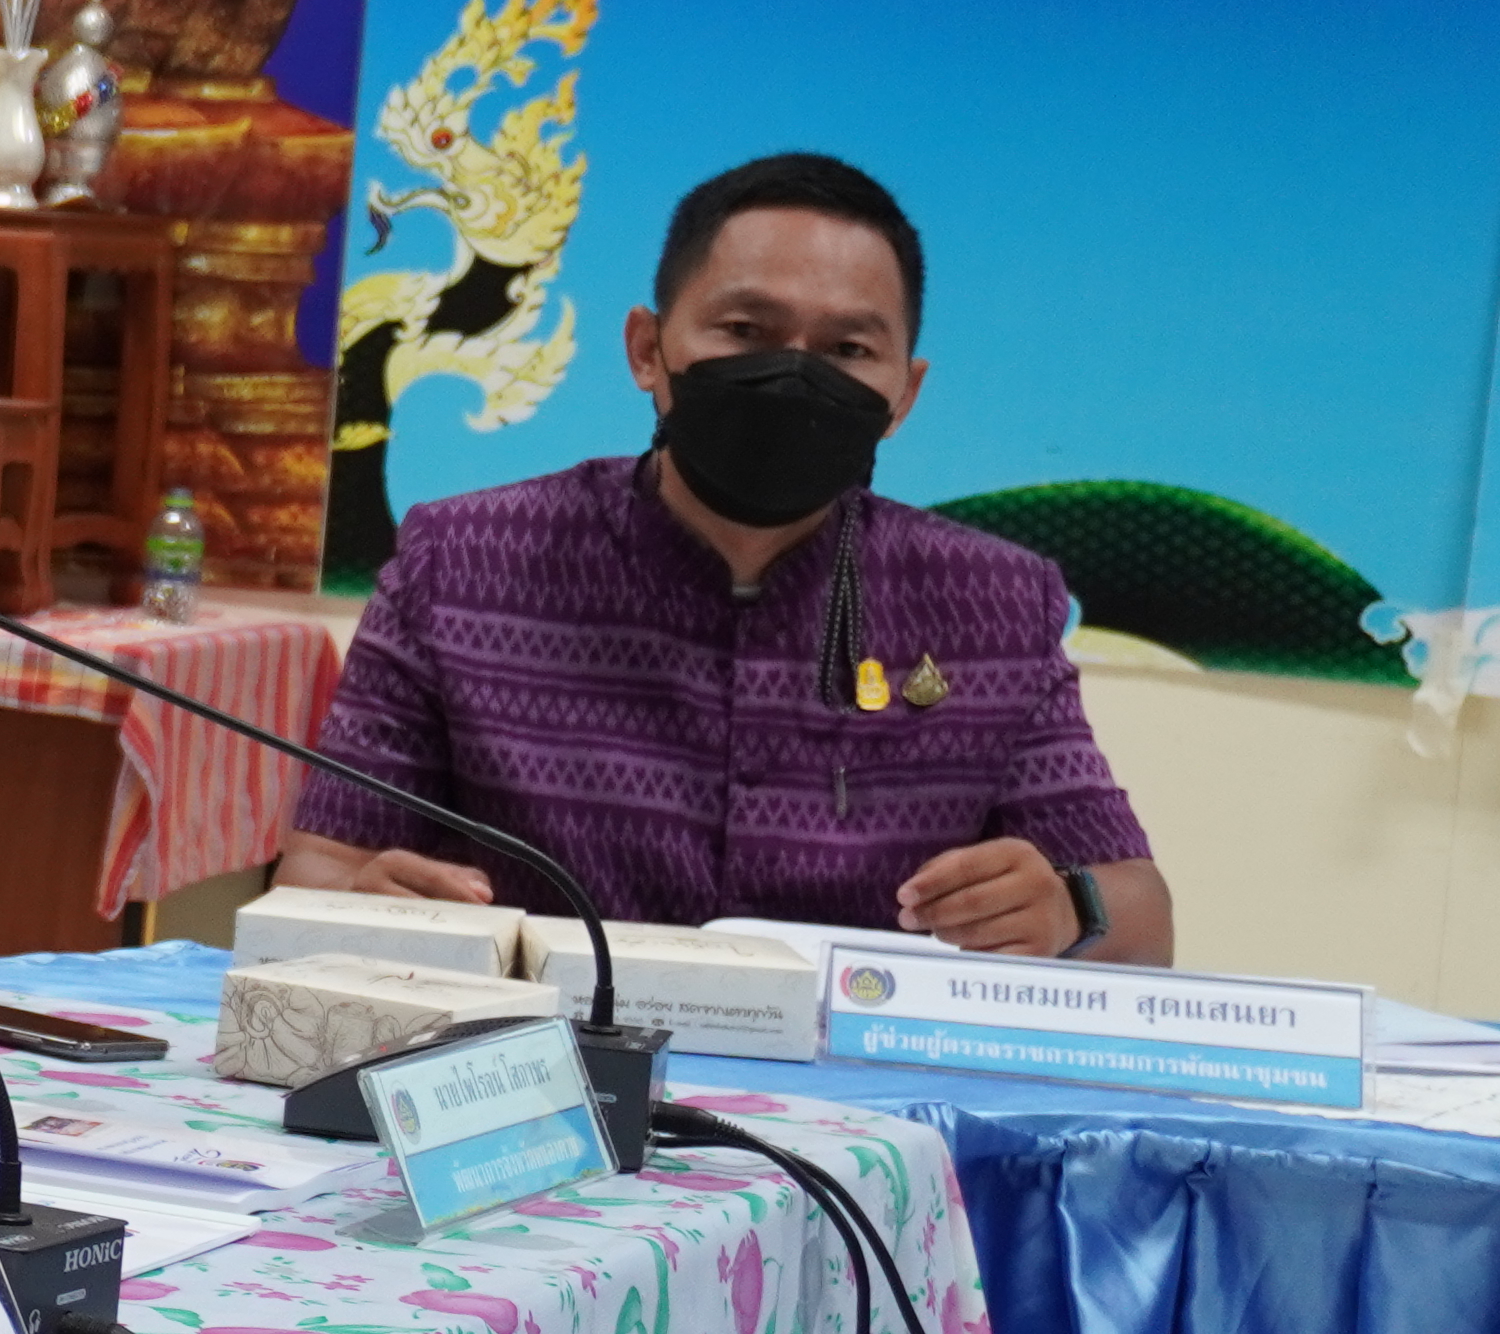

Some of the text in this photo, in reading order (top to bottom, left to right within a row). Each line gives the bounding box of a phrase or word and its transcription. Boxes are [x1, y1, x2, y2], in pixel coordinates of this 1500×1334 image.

[947, 976, 1298, 1028] นายสมยศ สุดแสนยา
